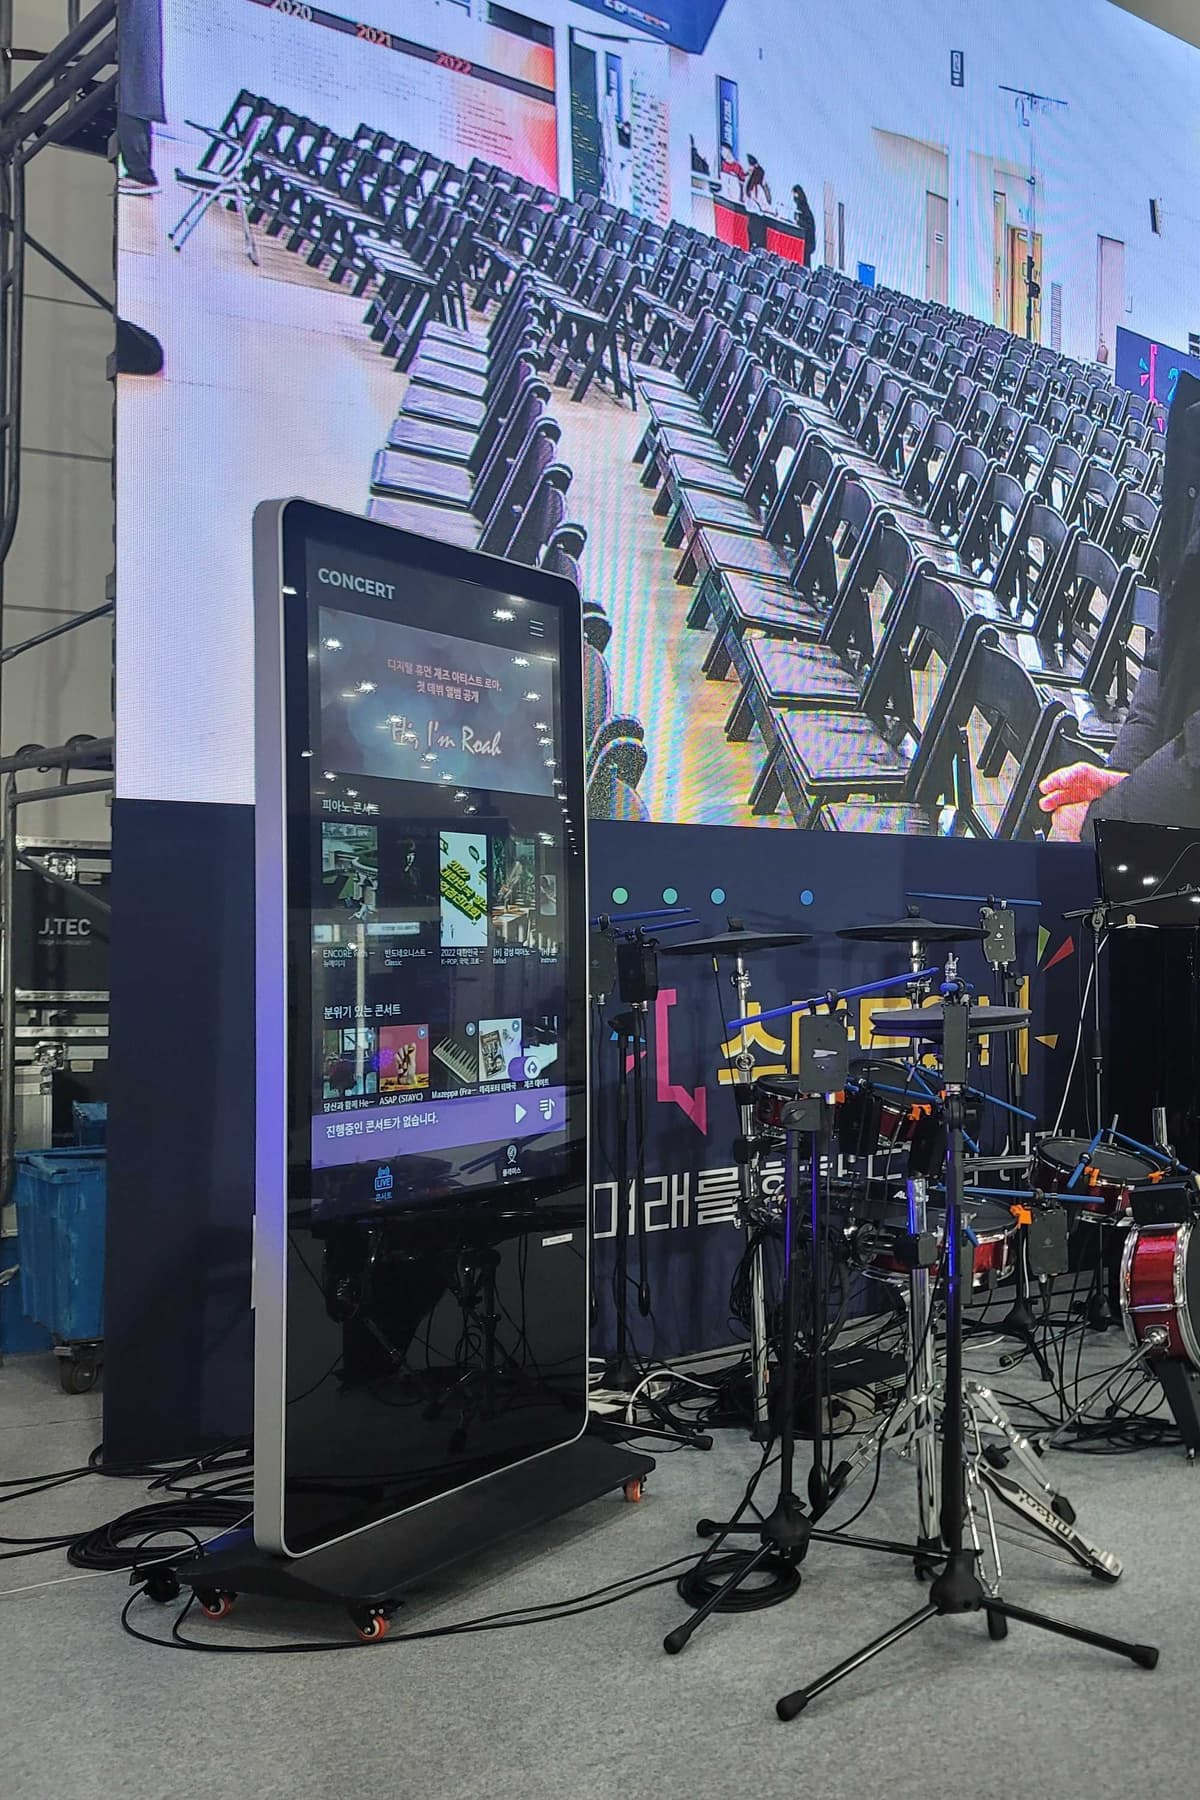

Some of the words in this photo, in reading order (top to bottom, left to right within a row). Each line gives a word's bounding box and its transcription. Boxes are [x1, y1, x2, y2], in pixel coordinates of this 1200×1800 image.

[435, 50, 473, 76] 2022
[317, 567, 396, 600] CONCERT
[451, 671, 483, 687] 아티스트
[461, 725, 502, 756] Roah
[322, 799, 352, 813] 피아노
[38, 917, 92, 935] J.TEC
[323, 1004, 352, 1020] 분위기
[353, 1004, 373, 1018] 있는
[374, 1002, 402, 1017] 콘서트
[379, 1096, 398, 1106] ASAP
[398, 1092, 424, 1104] (STAYC)
[325, 1120, 363, 1139] 진행중인
[365, 1115, 400, 1134] 콘서트가
[402, 1111, 439, 1129] 없습니다.
[592, 1166, 742, 1239] 미래를
